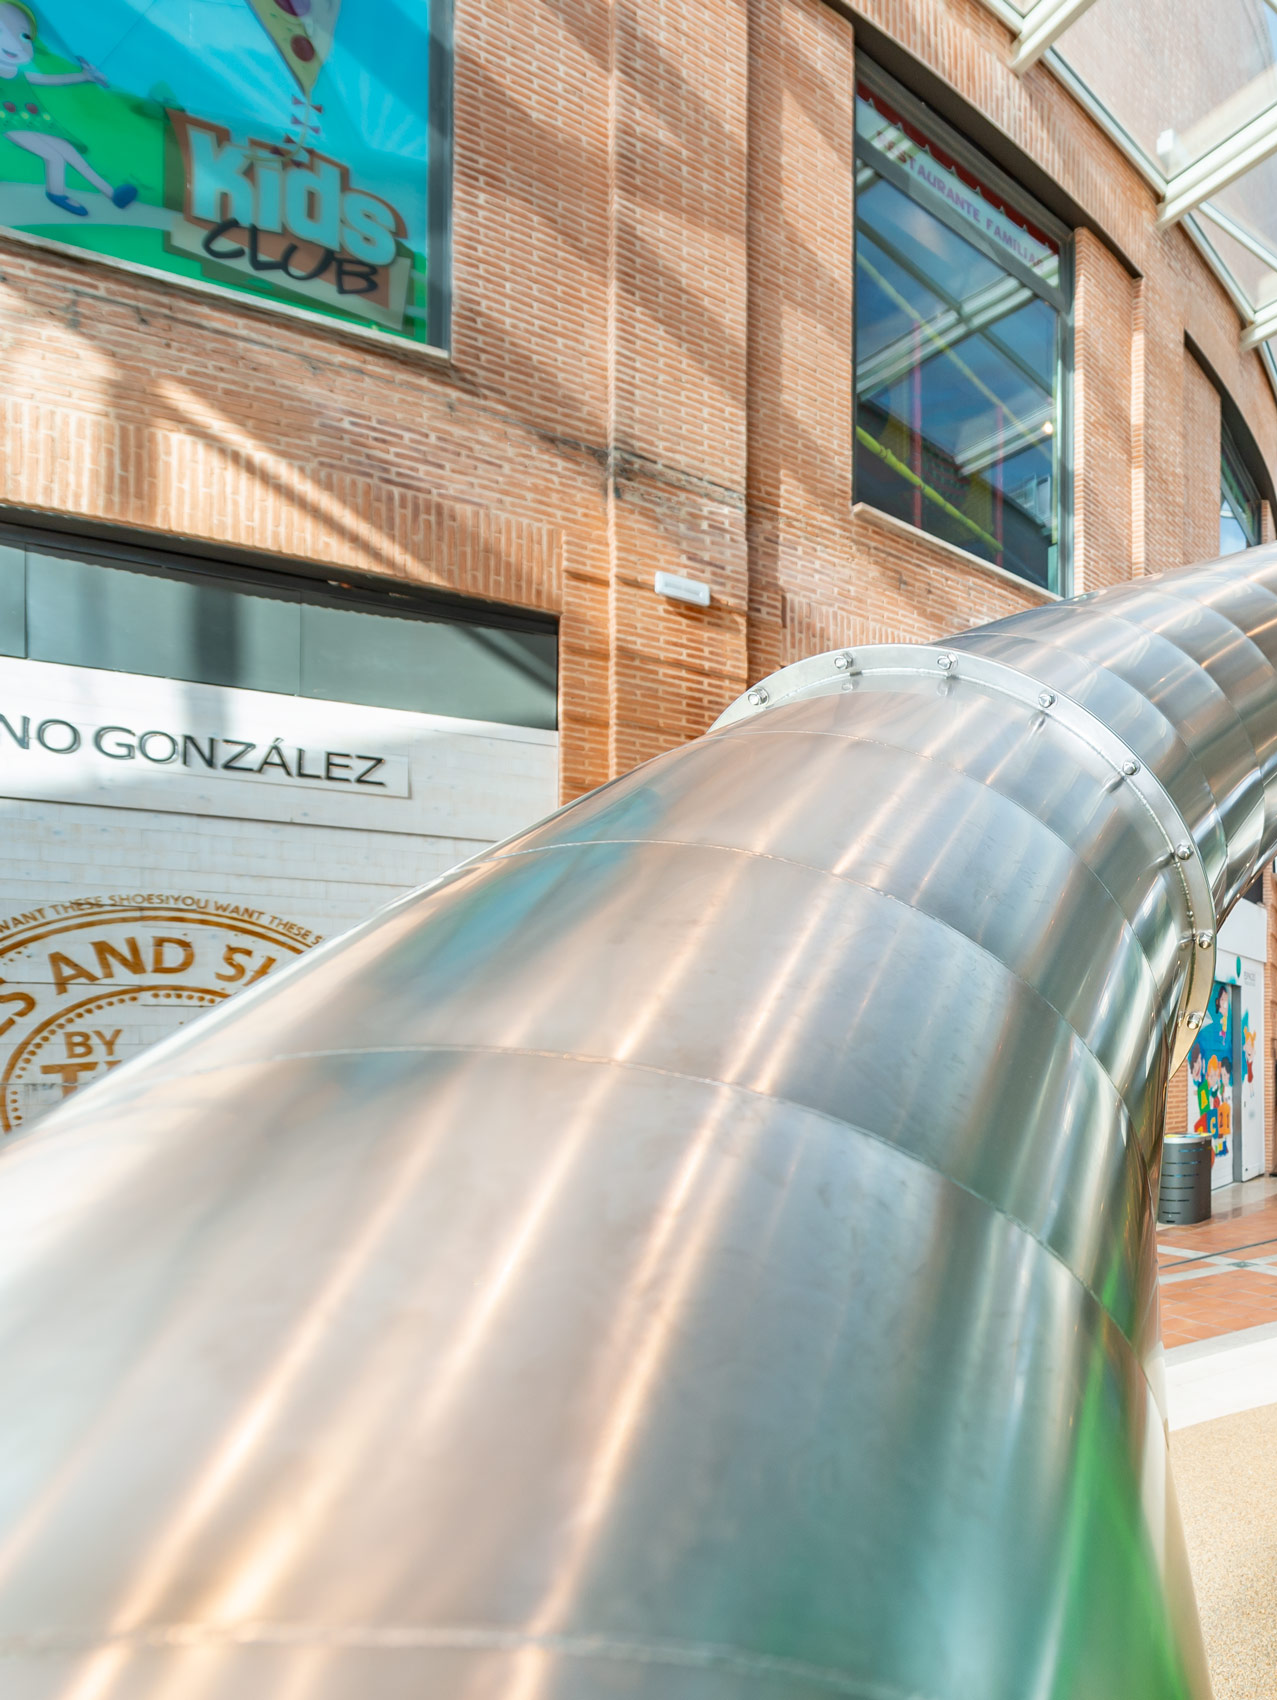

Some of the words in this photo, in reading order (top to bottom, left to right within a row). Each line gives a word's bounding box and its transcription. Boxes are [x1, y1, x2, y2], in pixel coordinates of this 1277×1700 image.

[187, 124, 397, 266] Kids
[203, 218, 380, 295] CLUB
[93, 726, 386, 788] GONZÁLEZ
[48, 896, 104, 916] THESE
[214, 901, 265, 921] WANT
[269, 915, 312, 940] THESE
[48, 936, 195, 995] AND
[63, 1029, 123, 1059] BY
